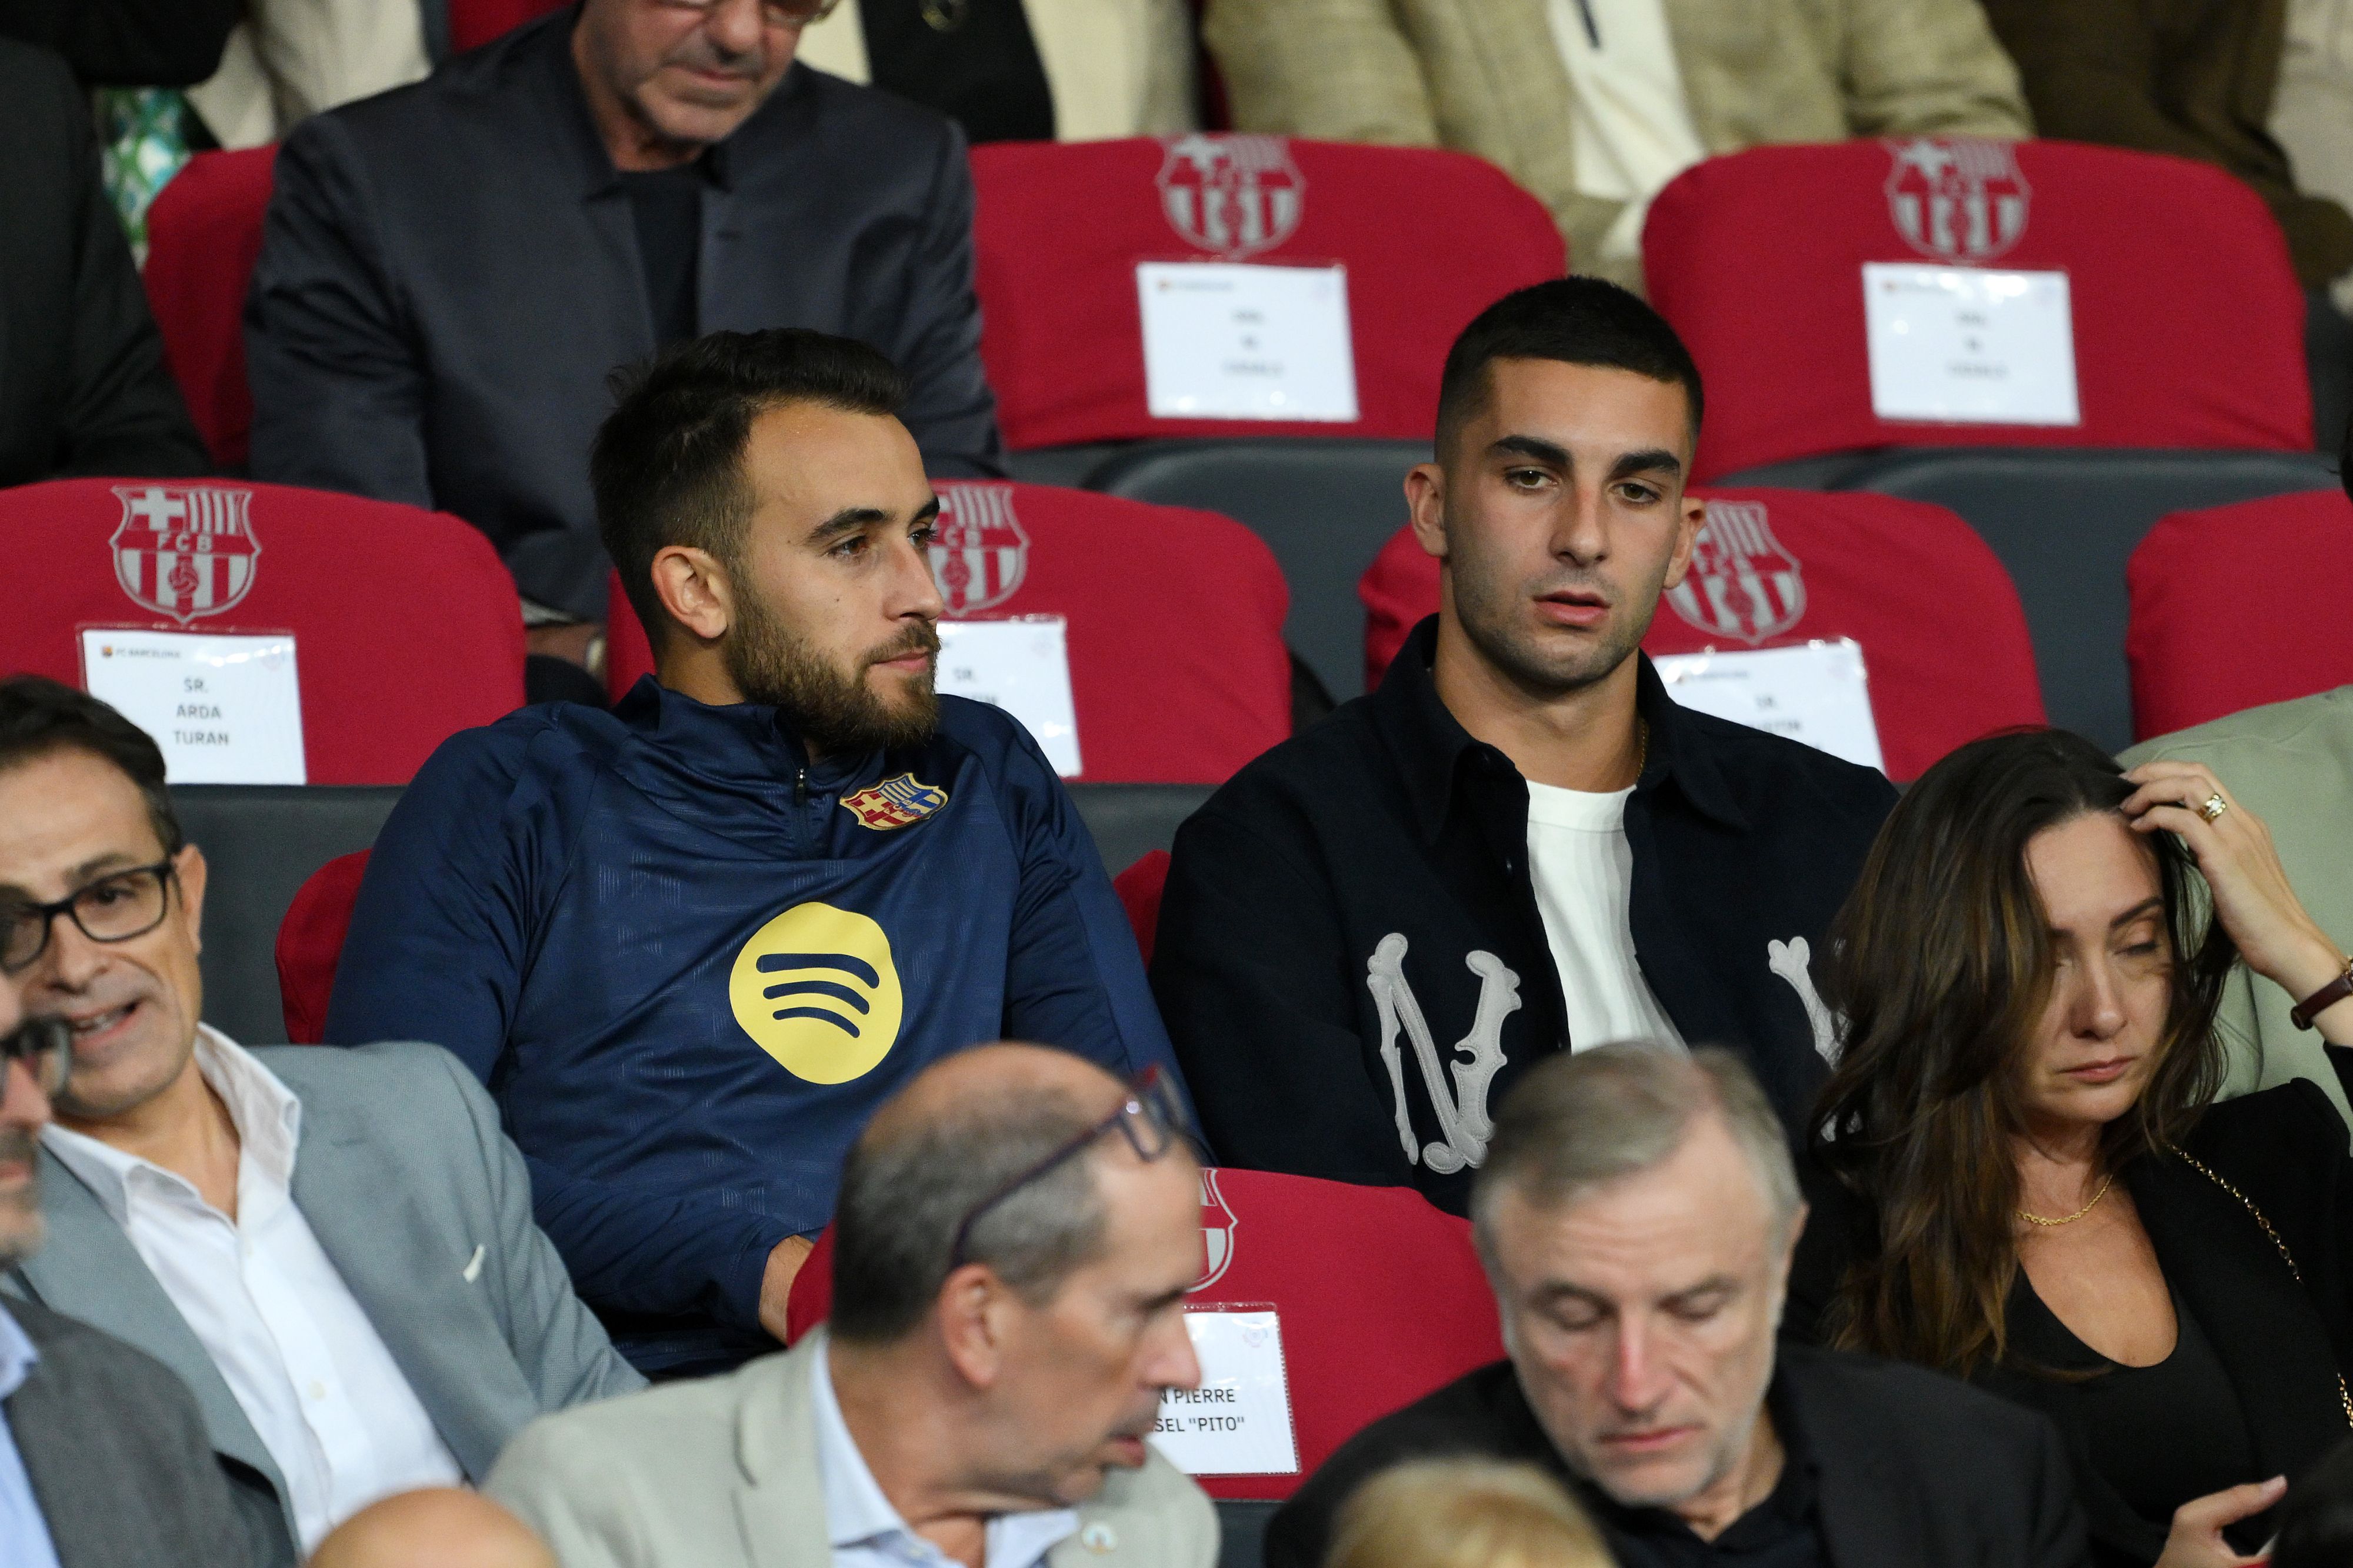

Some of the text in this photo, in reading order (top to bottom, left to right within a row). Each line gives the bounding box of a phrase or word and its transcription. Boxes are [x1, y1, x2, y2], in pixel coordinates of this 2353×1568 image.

[157, 531, 212, 552] FCB
[184, 678, 209, 693] SR.
[176, 705, 222, 720] ARDA
[174, 730, 229, 746] TURAN
[1174, 1388, 1236, 1404] PIERRE
[1189, 1416, 1244, 1431] "PITO"
